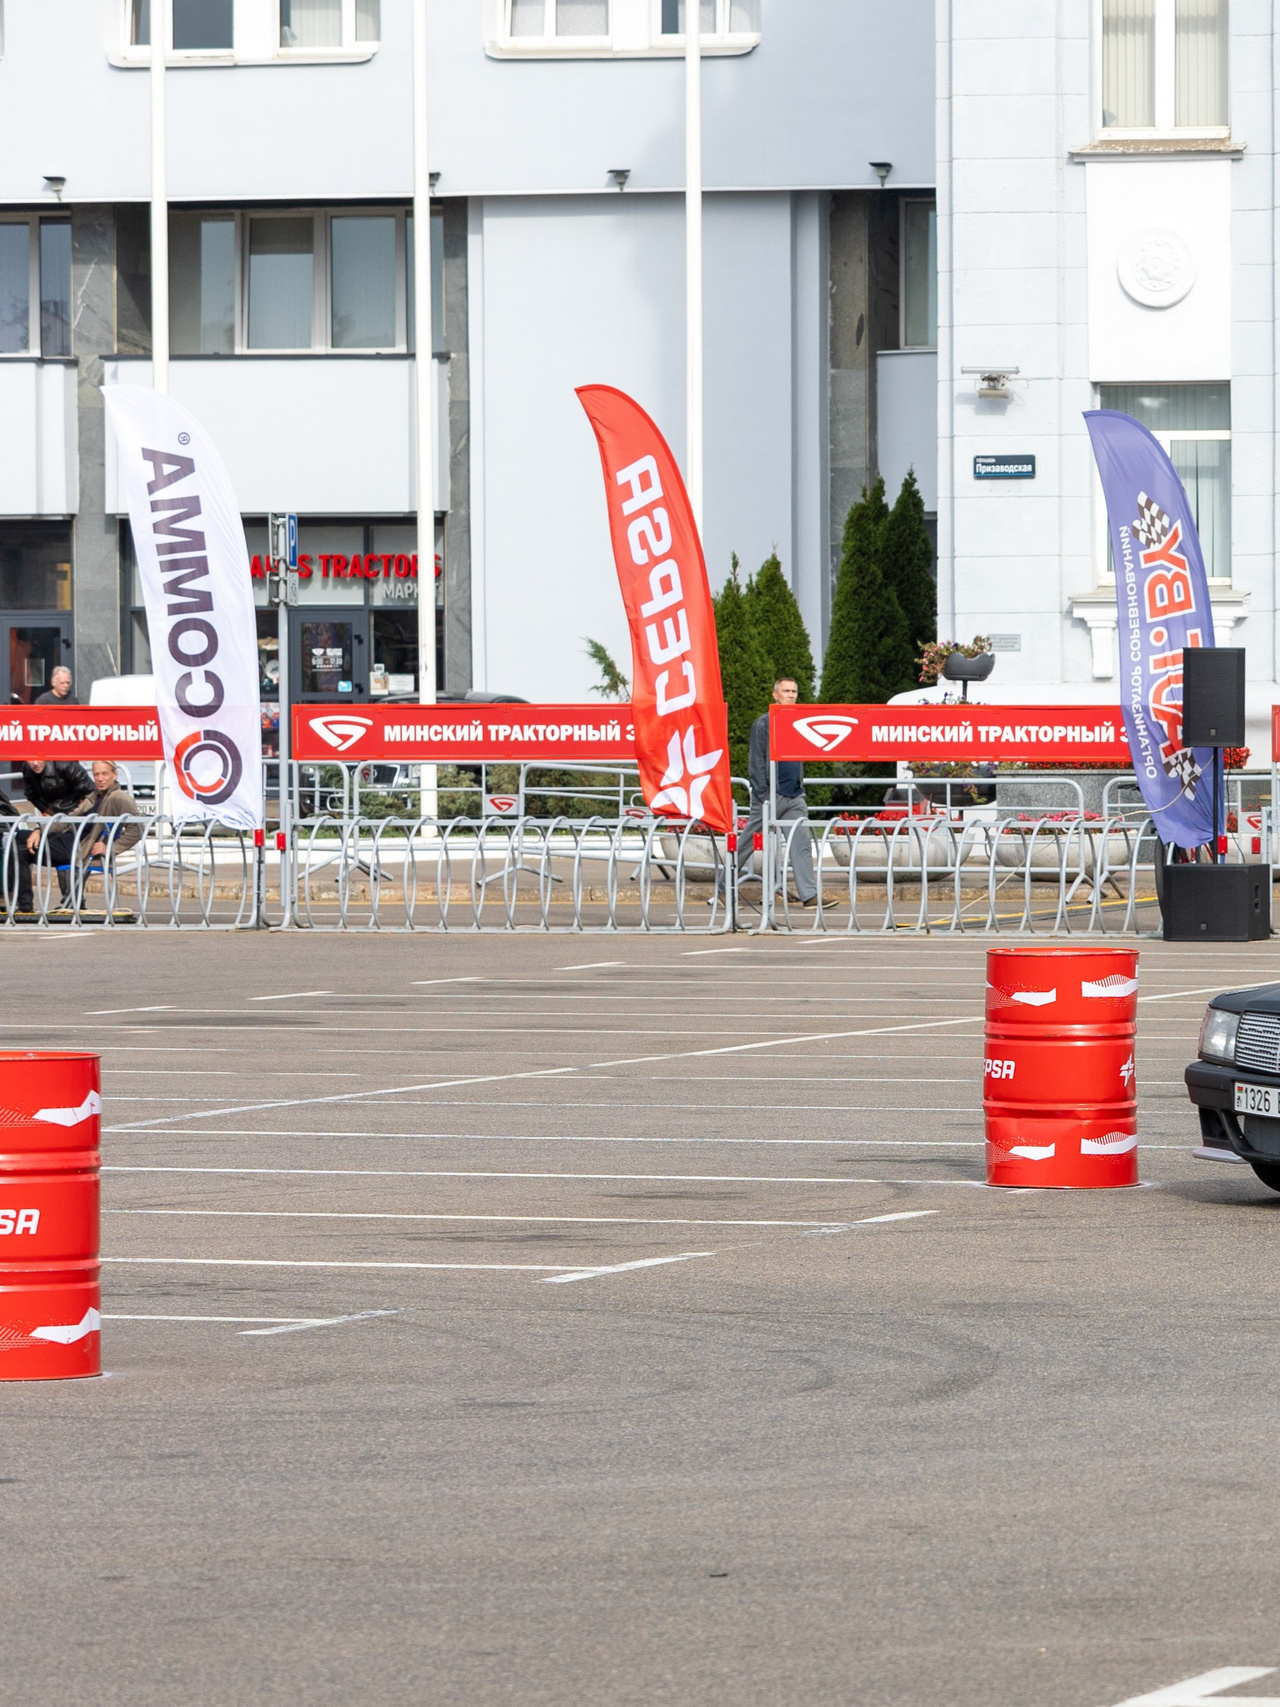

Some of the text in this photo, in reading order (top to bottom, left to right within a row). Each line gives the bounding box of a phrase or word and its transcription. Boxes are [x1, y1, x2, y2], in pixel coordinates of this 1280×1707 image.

[976, 464, 1032, 474] Призаводская
[27, 720, 159, 741] ТРАКТОРНЫЙ
[384, 720, 483, 742] МИНСКИЙ
[488, 720, 621, 742] ТРАКТОРНЫЙ
[872, 722, 973, 742] МИНСКИЙ
[978, 721, 1115, 743] ТРАКТОРНЫЙ
[1244, 1087, 1271, 1113] 1326
